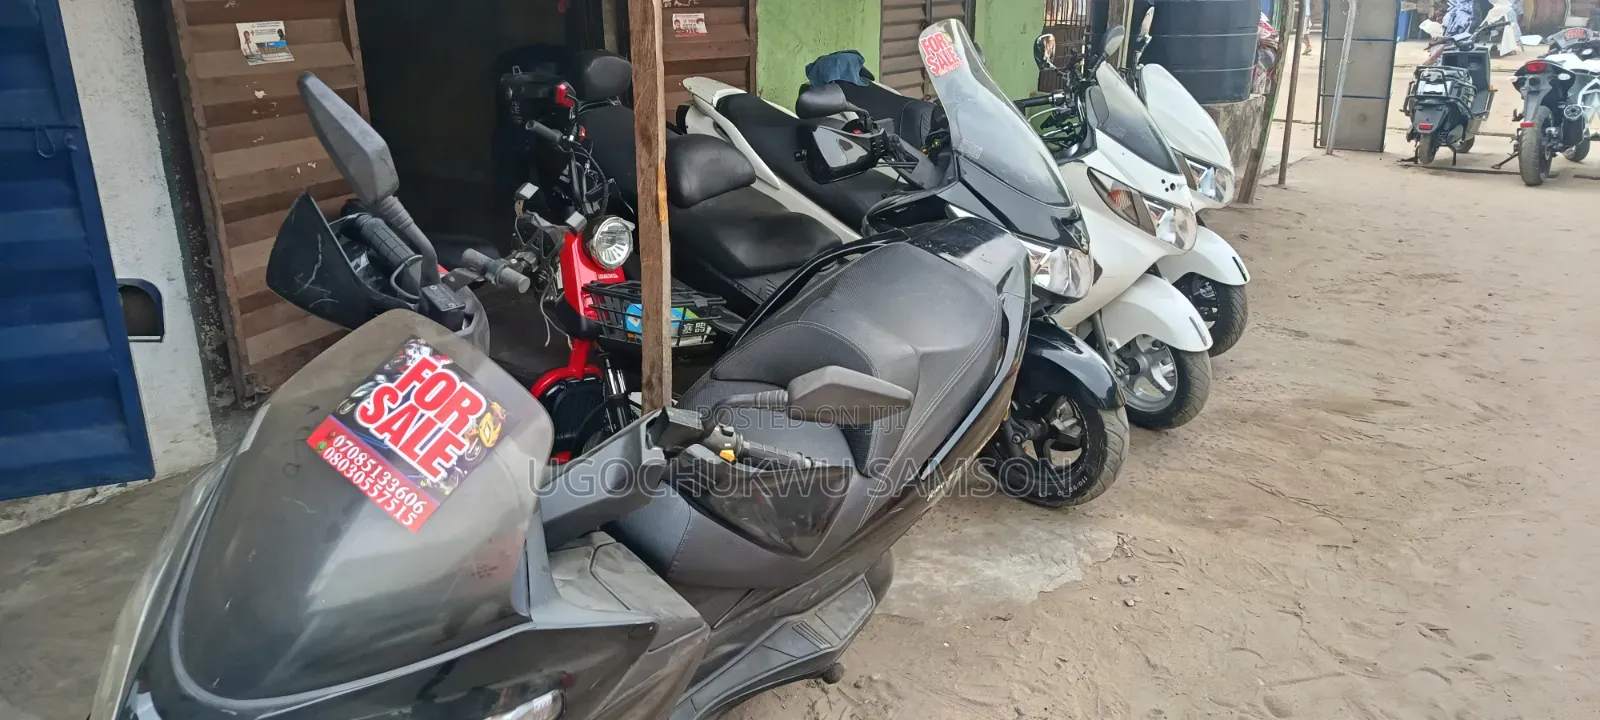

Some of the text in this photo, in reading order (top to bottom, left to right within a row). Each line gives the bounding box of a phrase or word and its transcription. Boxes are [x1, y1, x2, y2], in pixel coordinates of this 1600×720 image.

[919, 32, 949, 57] FOR
[926, 45, 960, 74] SALE
[357, 384, 469, 481] SALE
[394, 355, 486, 437] FOR
[323, 447, 418, 526] 08030557515
[333, 434, 427, 515] 07085133606
